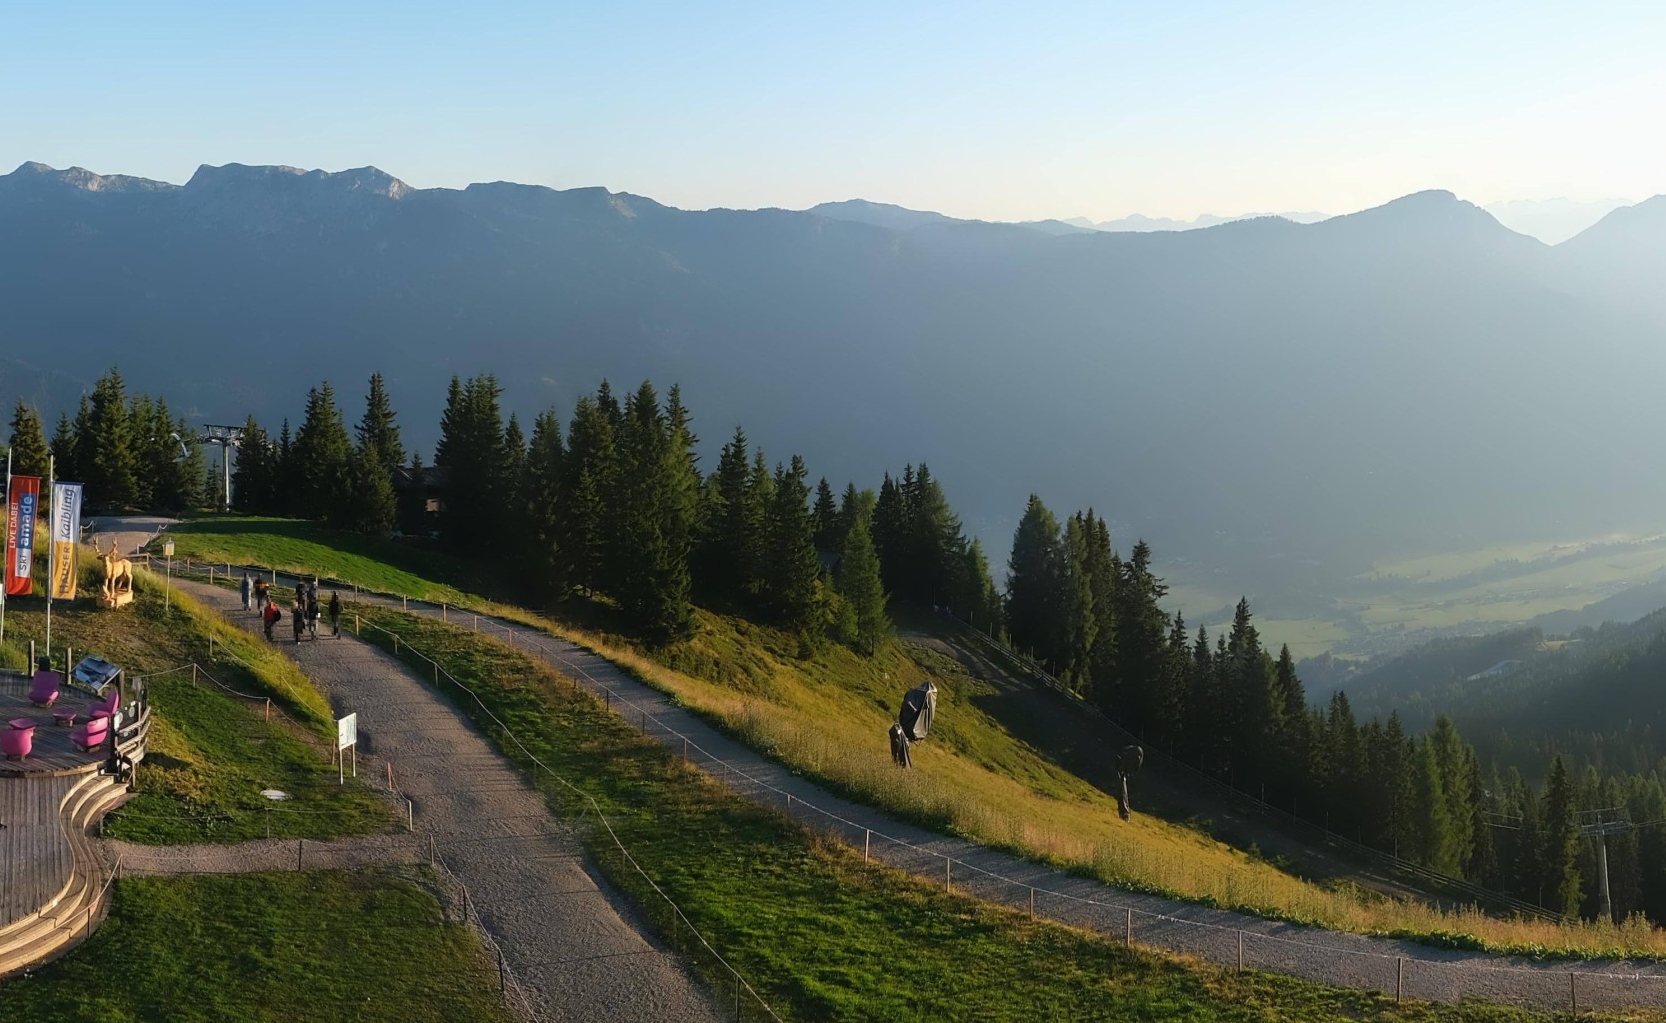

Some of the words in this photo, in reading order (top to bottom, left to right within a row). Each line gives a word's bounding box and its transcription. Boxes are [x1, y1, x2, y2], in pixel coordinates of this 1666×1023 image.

[60, 488, 76, 539] Kaibling
[9, 529, 17, 549] LIVE
[19, 554, 27, 571] Ski
[59, 546, 71, 594] HAUSER
